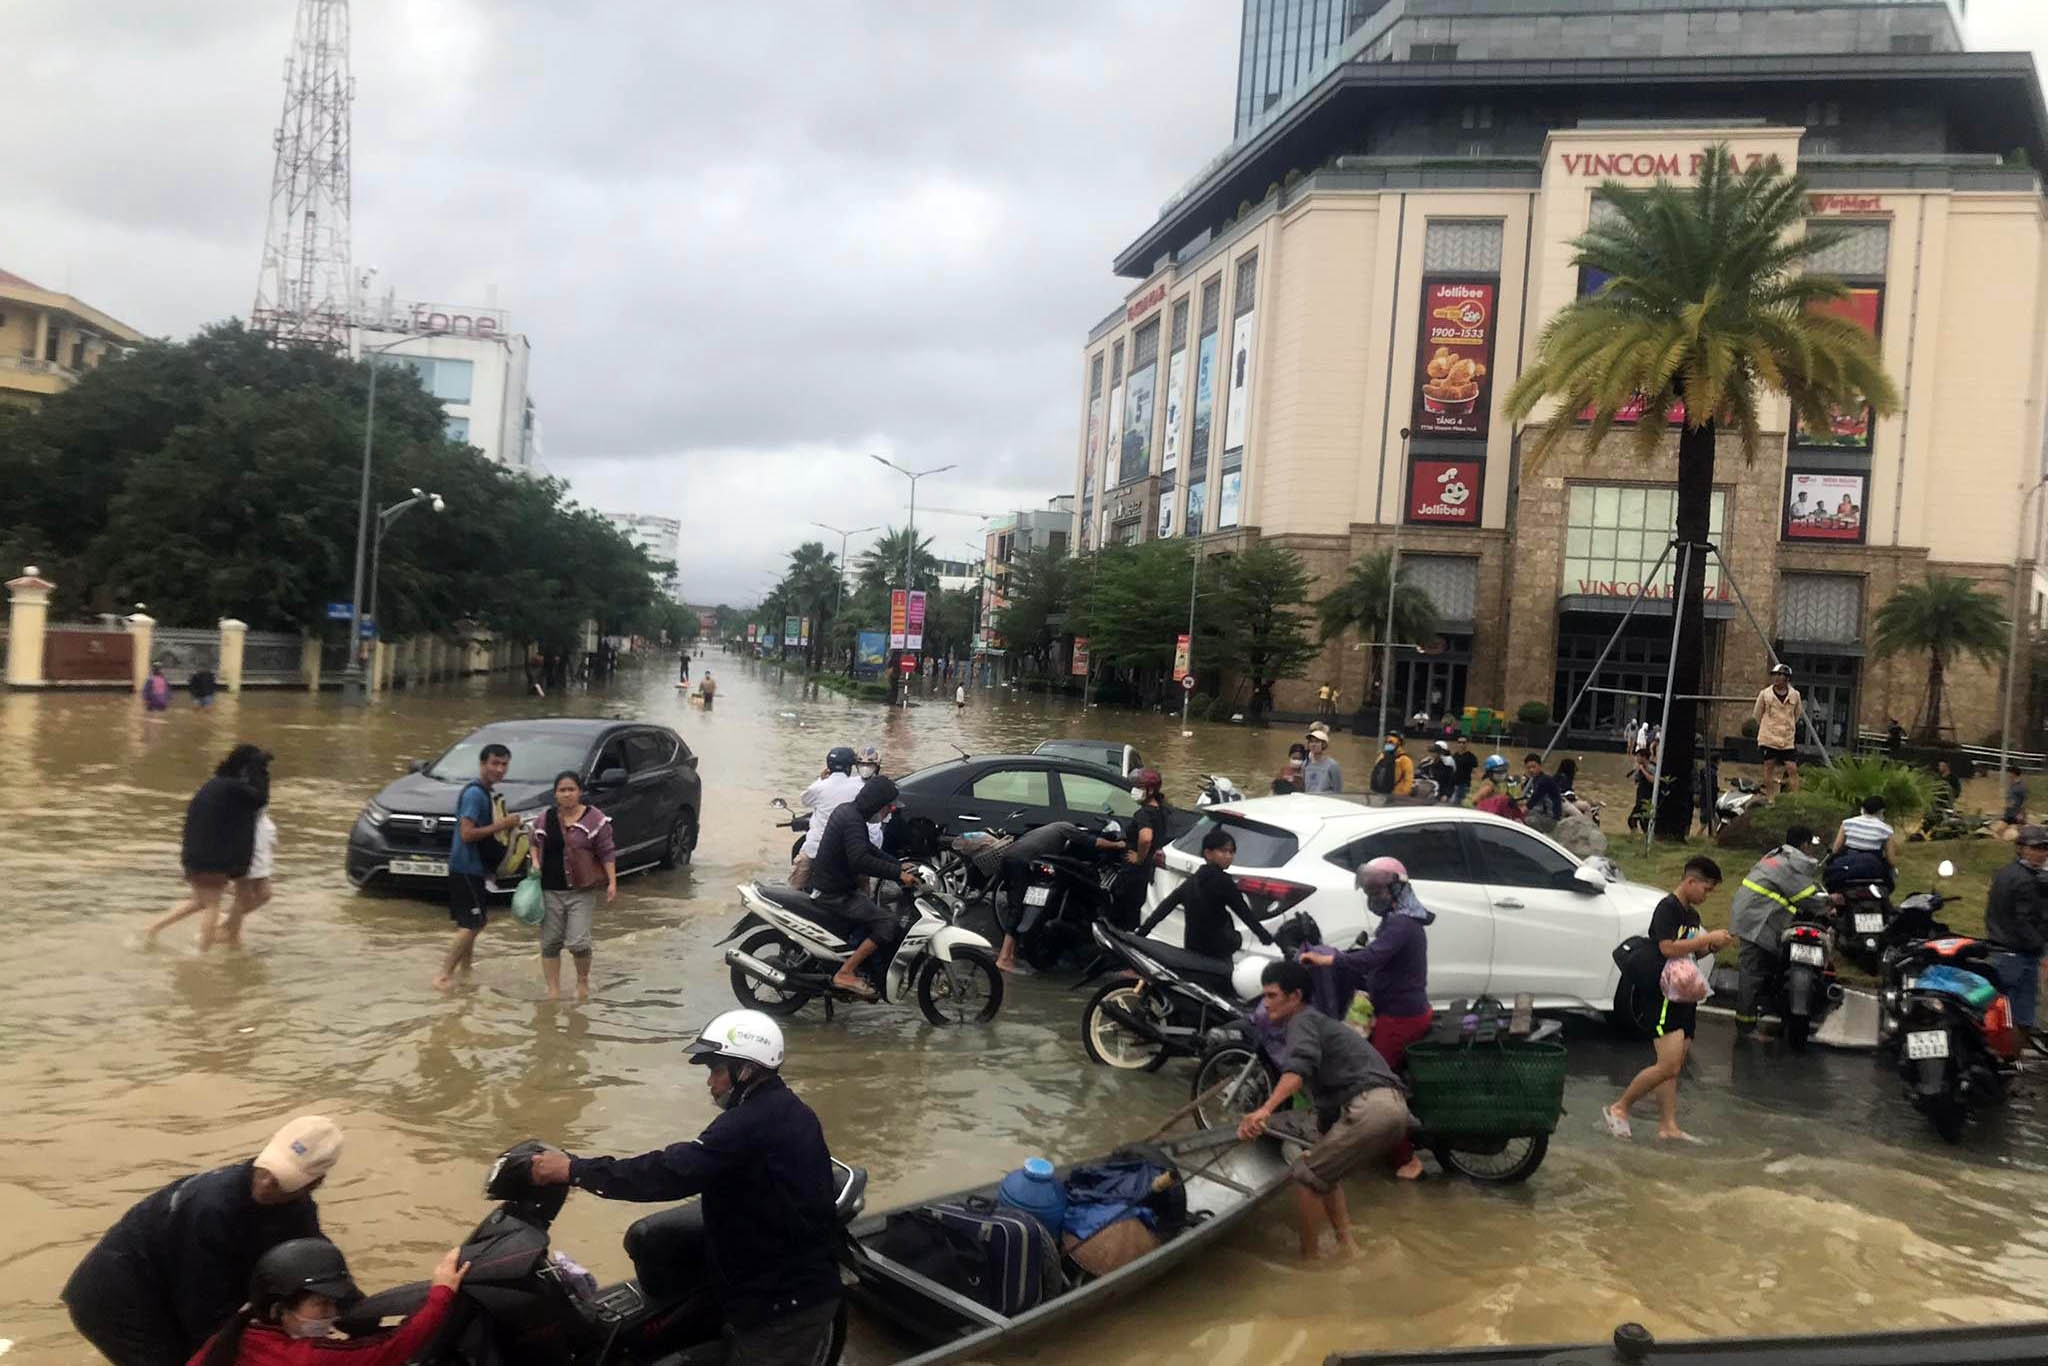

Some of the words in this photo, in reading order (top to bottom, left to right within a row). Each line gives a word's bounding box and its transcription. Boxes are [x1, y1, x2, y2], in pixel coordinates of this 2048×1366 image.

[1561, 154, 1681, 176] VINCOM
[1437, 284, 1484, 298] Jollibee
[1431, 327, 1484, 338] 1900-1533
[1417, 503, 1466, 516] Jollibee
[1577, 579, 1659, 599] VINCOM
